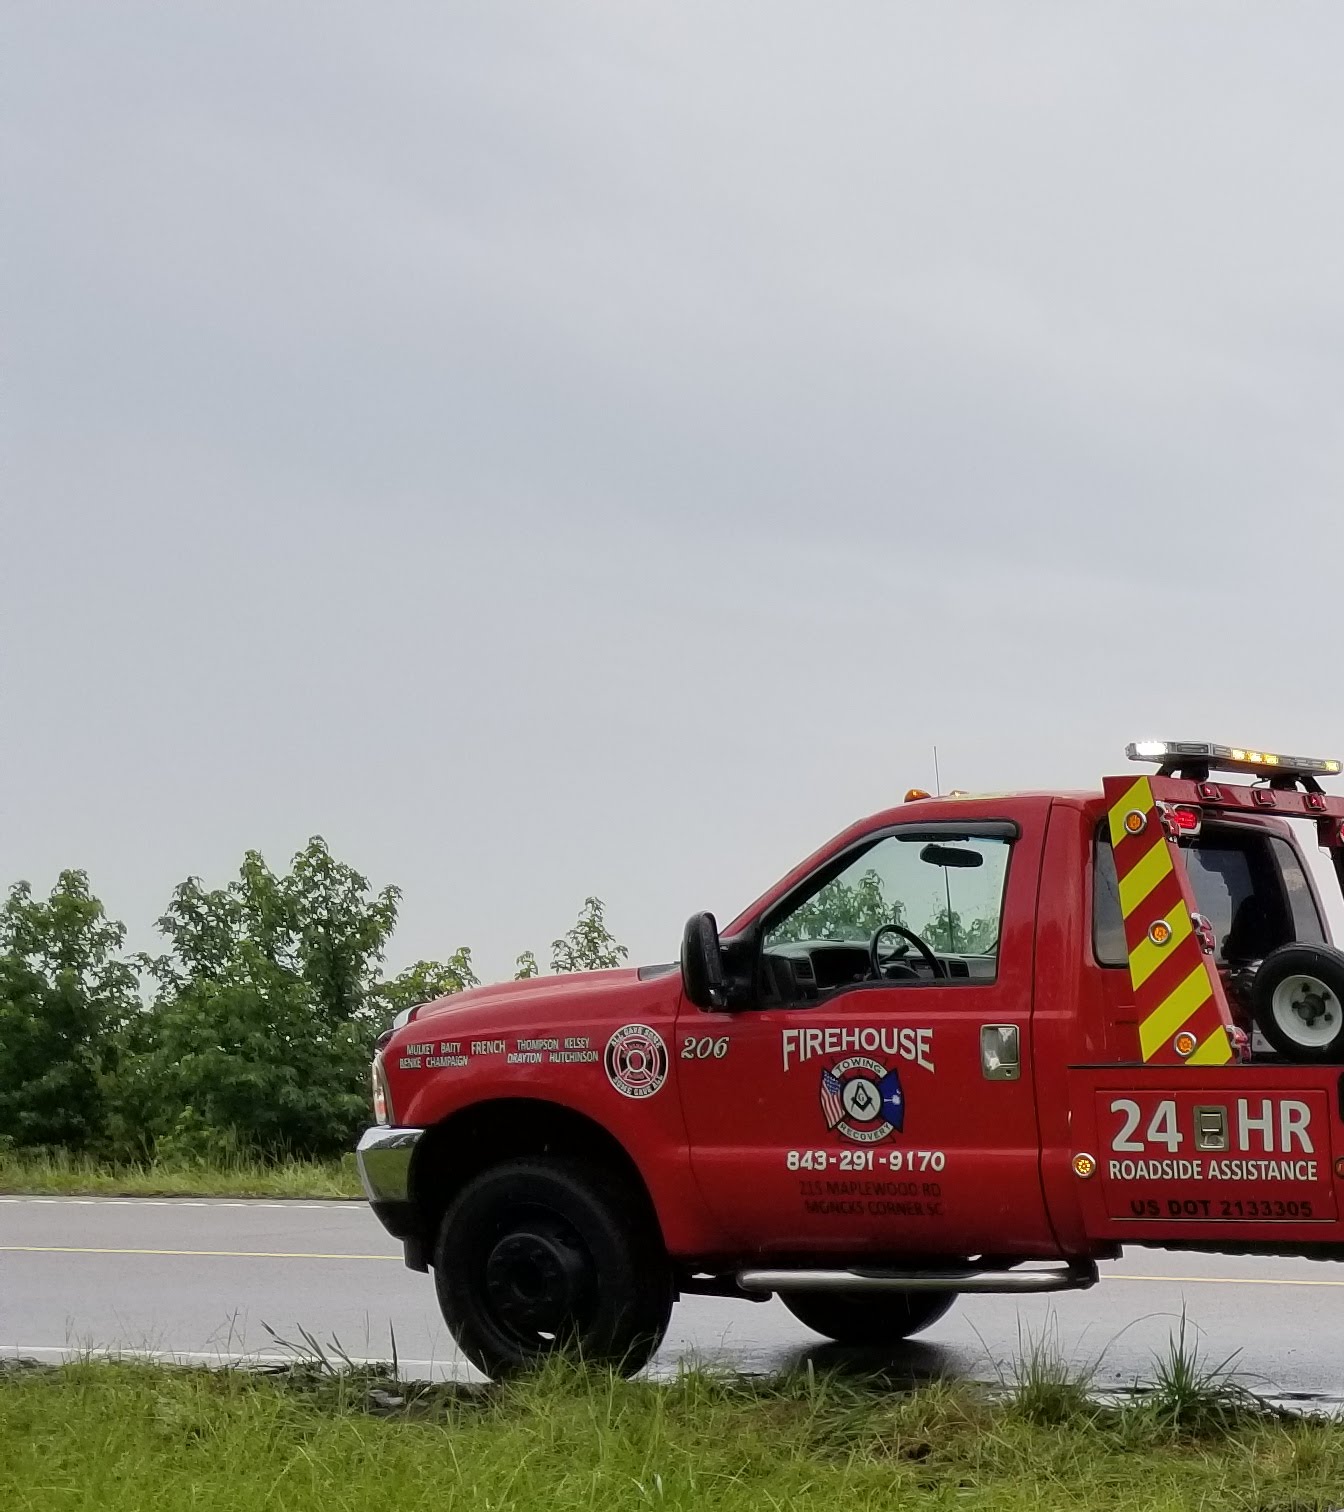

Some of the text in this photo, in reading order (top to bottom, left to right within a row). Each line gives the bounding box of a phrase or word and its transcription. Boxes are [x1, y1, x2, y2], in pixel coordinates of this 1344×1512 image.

[471, 1040, 506, 1055] FRENCH
[517, 1038, 559, 1051] THOMPSON
[564, 1037, 590, 1049] KELSEY
[681, 1036, 730, 1059] 206
[782, 1027, 935, 1074] FIREHOUSE
[425, 1055, 469, 1068] CHAMPAIGN
[507, 1052, 542, 1064] DRAYTON
[550, 1051, 599, 1063] HUTCHINSON
[835, 1057, 883, 1075] TOWING
[839, 1122, 892, 1141] RECOVERY
[1110, 1098, 1315, 1153] 24 HR
[786, 1150, 946, 1172] 843-291-9170
[1109, 1159, 1318, 1181] ROADSIDE ASSISTANCE
[826, 1182, 918, 1196] MAPLEWOOD
[922, 1182, 941, 1197] RD
[868, 1201, 925, 1216] CORNER
[1130, 1199, 1313, 1217] US DOT 2133305
